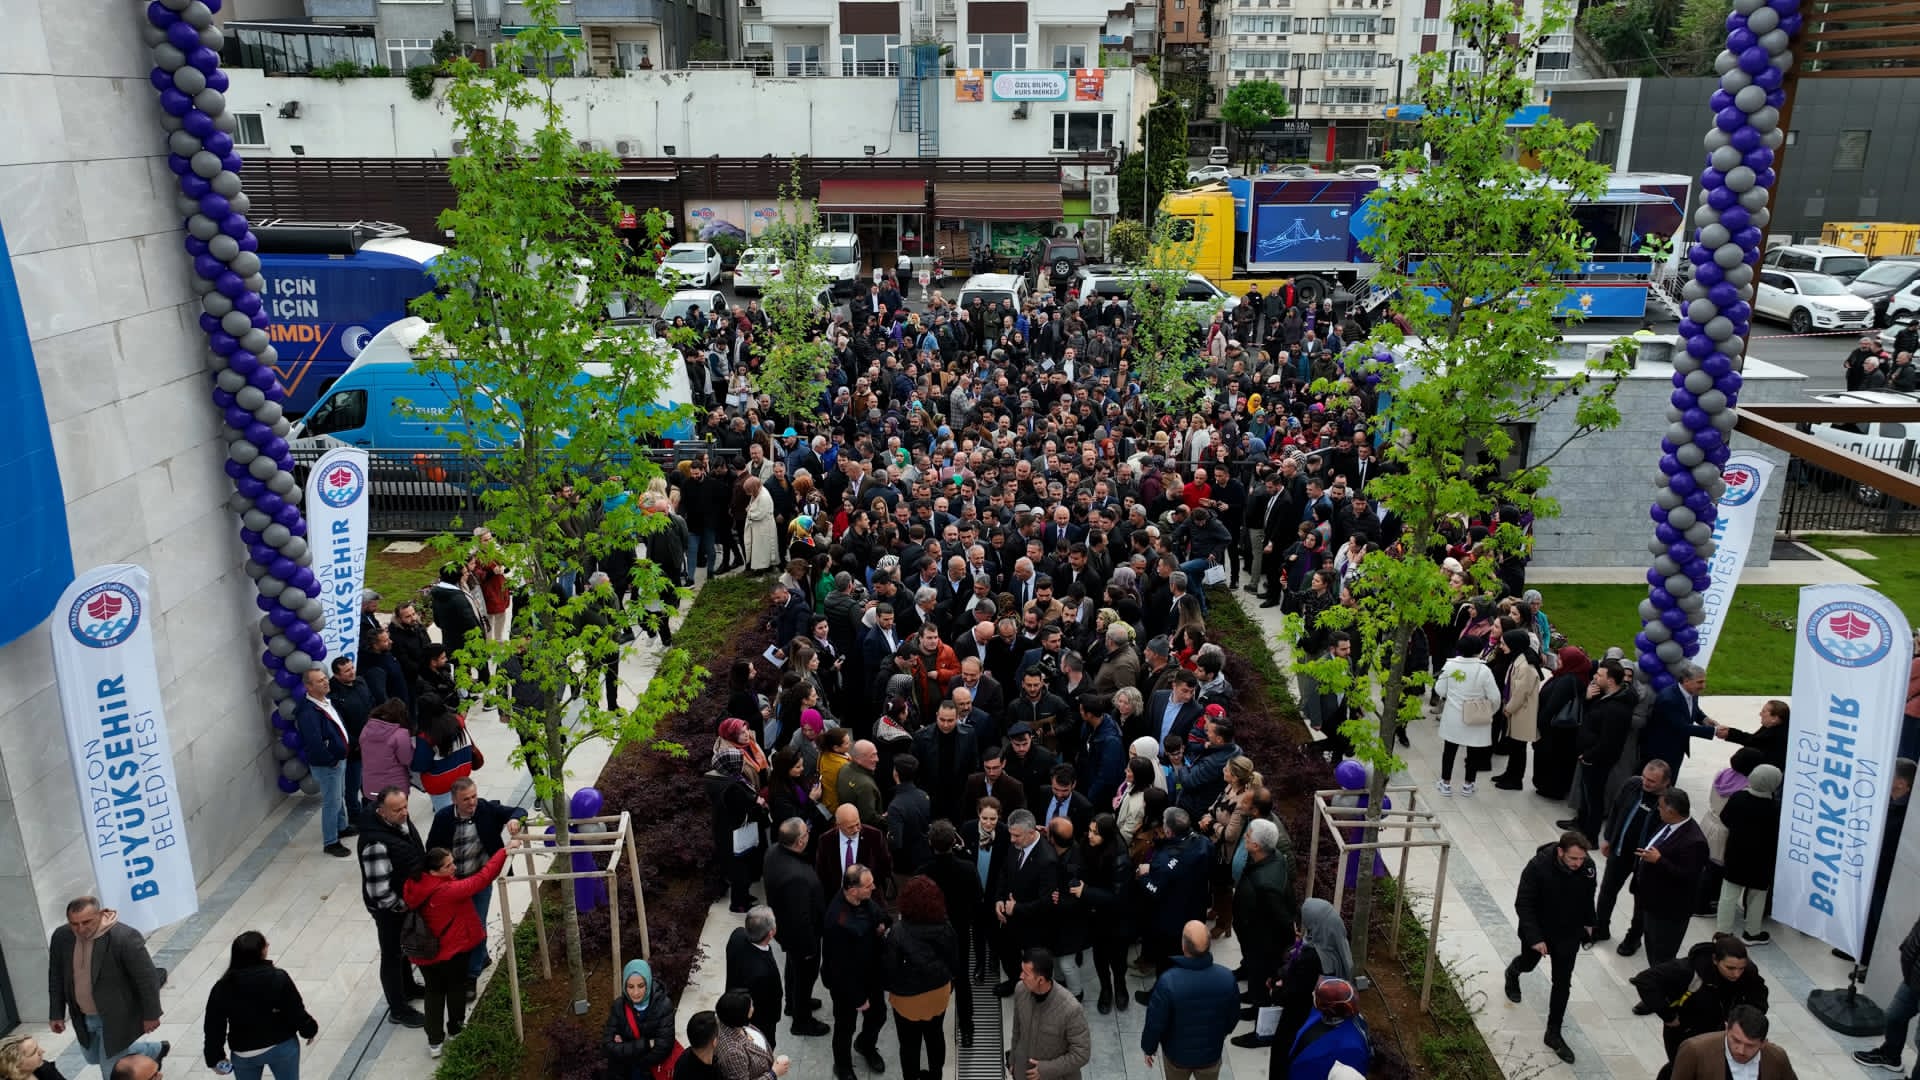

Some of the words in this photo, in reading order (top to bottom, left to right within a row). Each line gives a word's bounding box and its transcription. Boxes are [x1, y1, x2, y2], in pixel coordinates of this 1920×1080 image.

[272, 299, 319, 320] İÇİN
[274, 278, 317, 297] İÇİN
[265, 324, 321, 342] İMDİ
[84, 738, 118, 858] TRABZON
[97, 673, 160, 902] BÜYÜKŞEHİR
[134, 709, 176, 850] BELEDİYESİ
